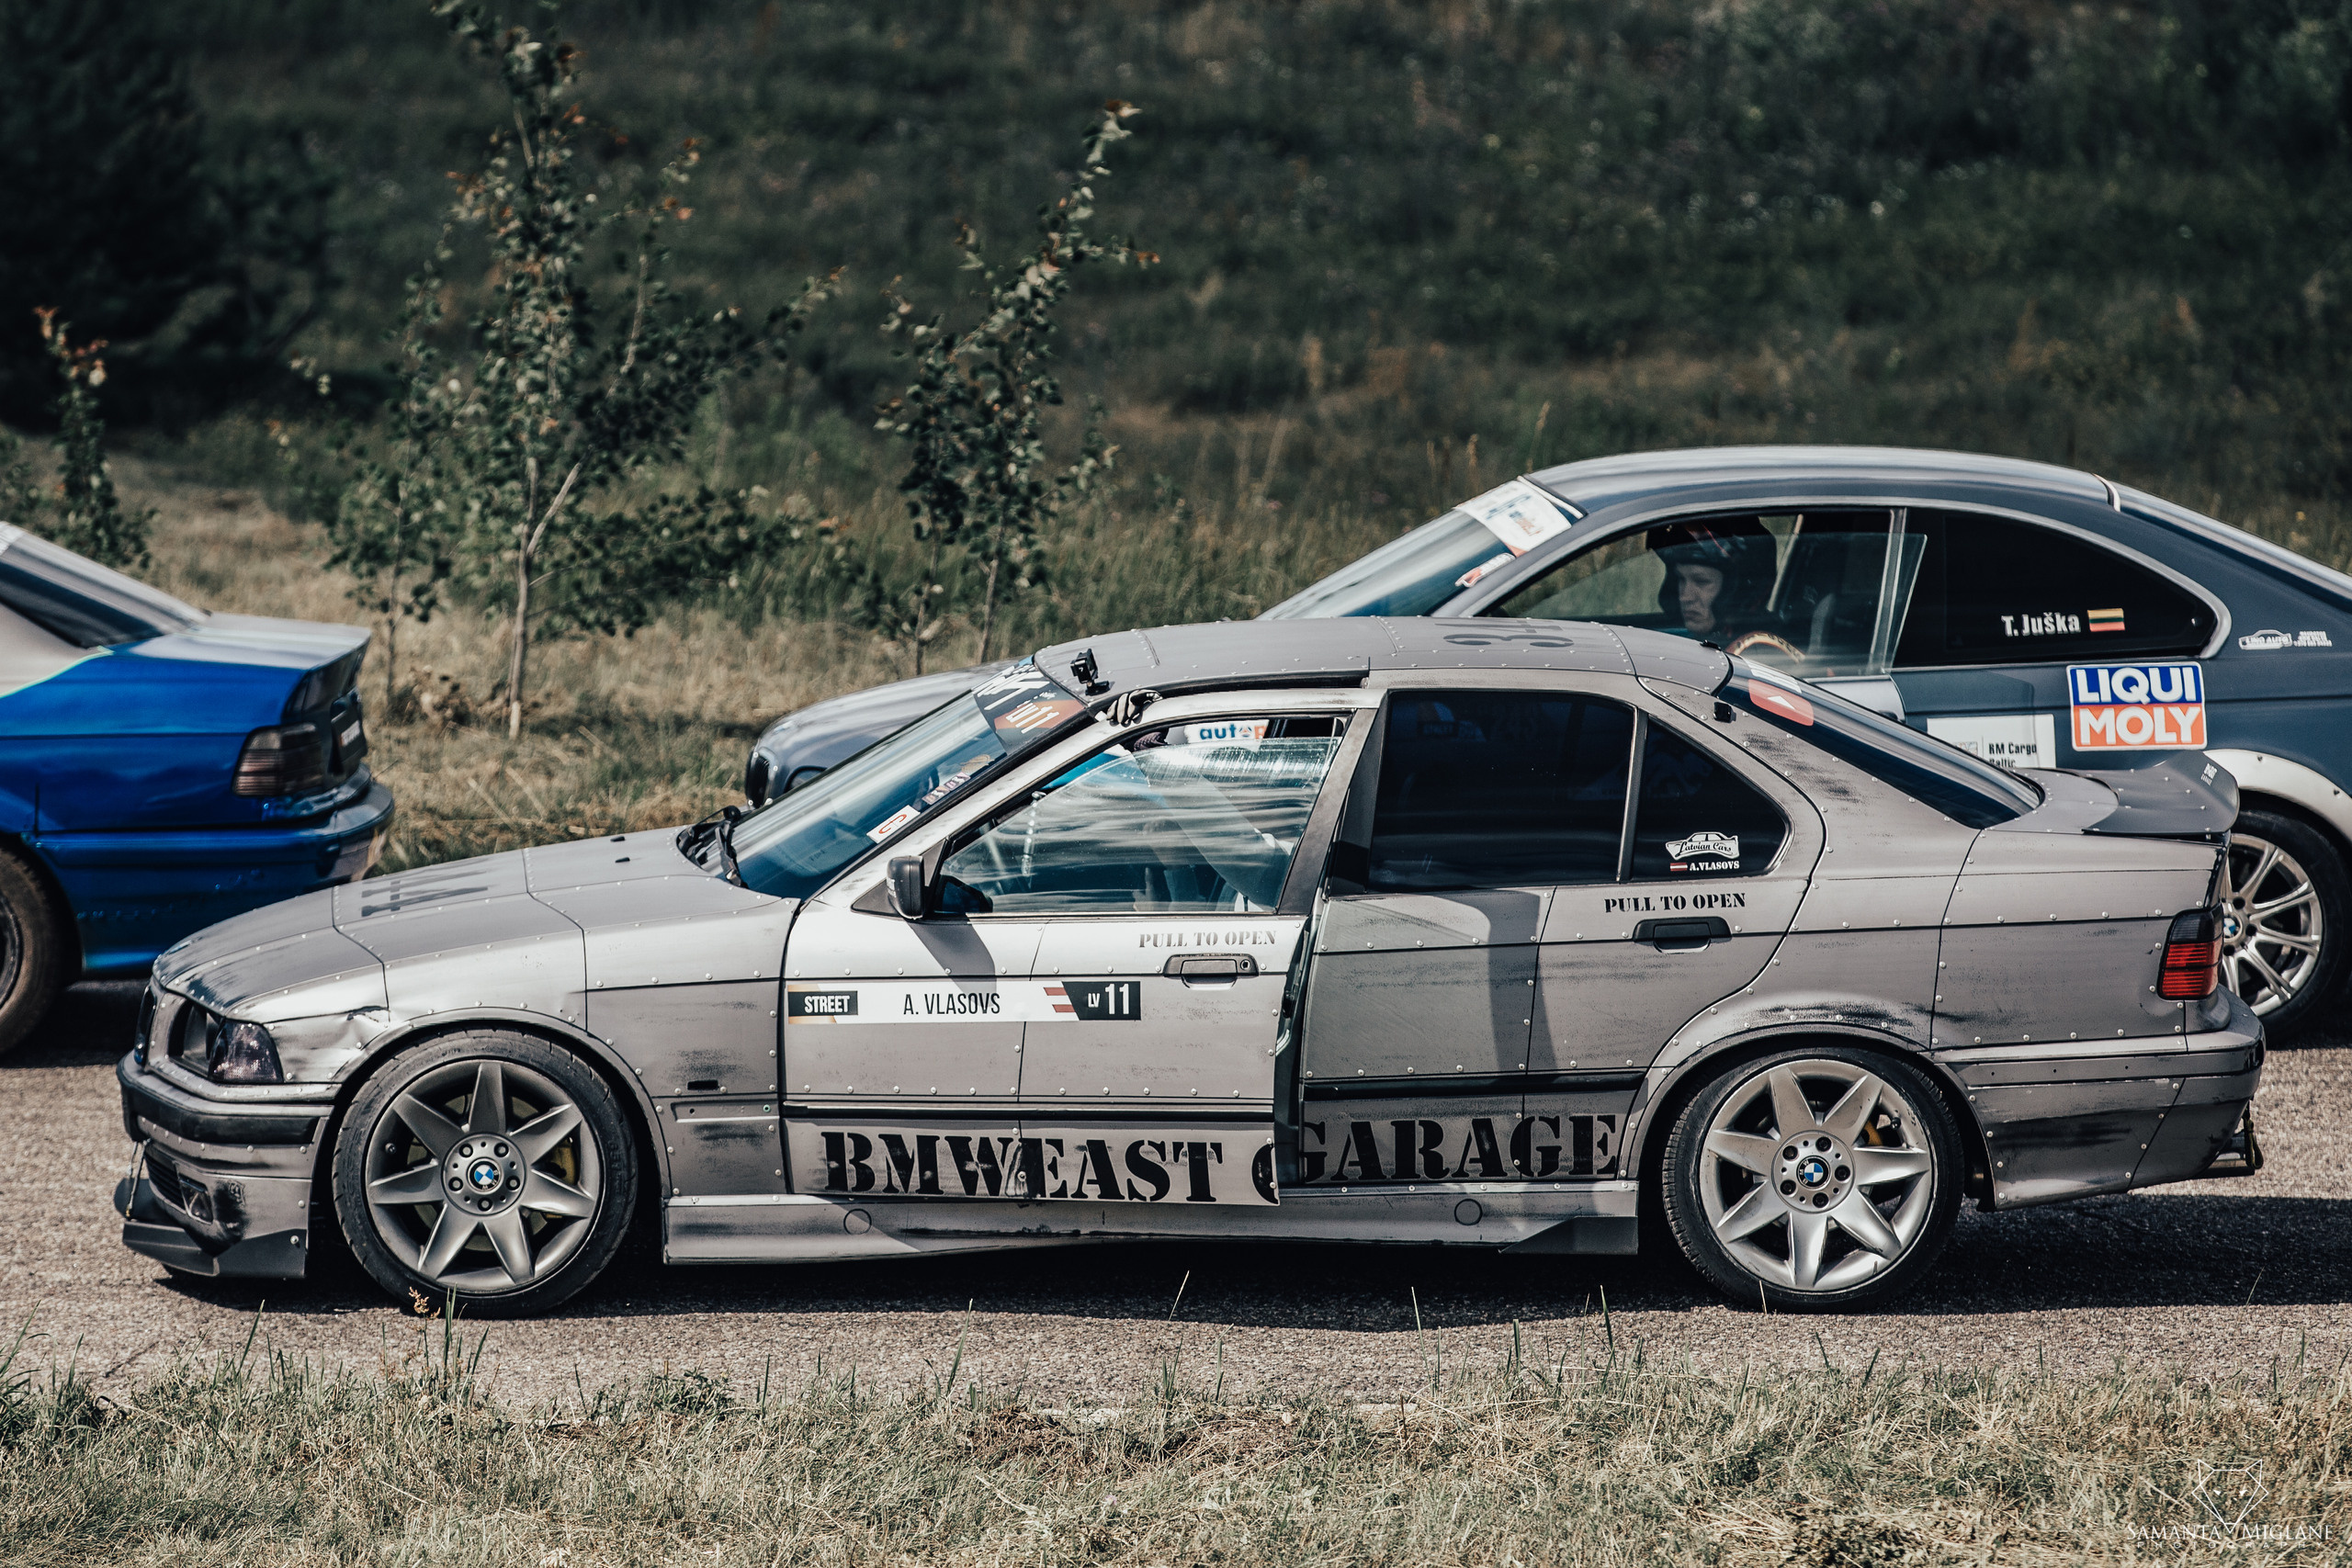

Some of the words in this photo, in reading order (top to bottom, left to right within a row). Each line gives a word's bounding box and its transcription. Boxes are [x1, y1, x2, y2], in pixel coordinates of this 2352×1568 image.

[2001, 615, 2019, 637] T.
[2021, 612, 2081, 637] Juška
[2076, 666, 2197, 706] LIQUI
[2079, 706, 2202, 746] MOLY
[1988, 742, 2005, 755] RM
[1675, 840, 1711, 858] Latvian
[1713, 841, 1733, 852] Cars
[1604, 896, 1657, 913] PULL
[1660, 895, 1687, 911] TO
[1692, 893, 1746, 909] OPEN
[1138, 932, 1188, 948] PULL
[1193, 931, 1219, 946] TO
[1225, 931, 1277, 946] OPEN
[804, 995, 850, 1014] STREET
[903, 993, 920, 1015] A.
[924, 992, 1001, 1015] VLASOVS
[1088, 992, 1101, 1009] LV
[1105, 983, 1130, 1015] 11
